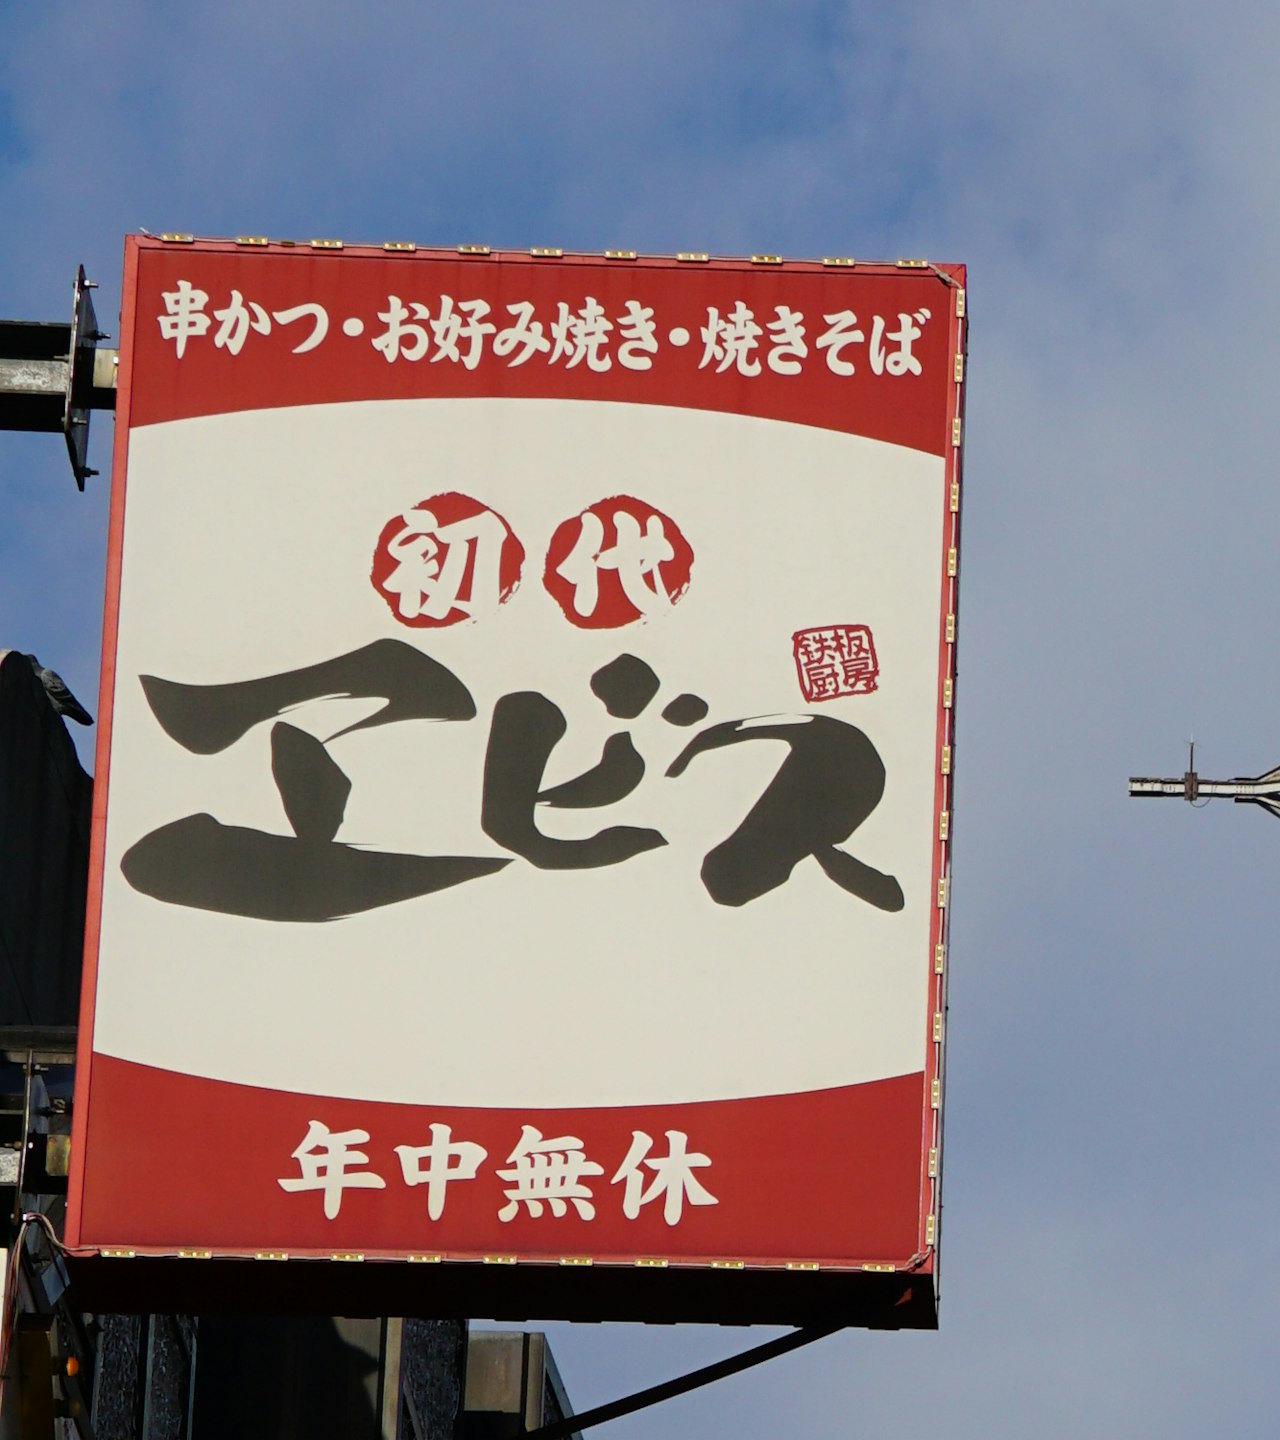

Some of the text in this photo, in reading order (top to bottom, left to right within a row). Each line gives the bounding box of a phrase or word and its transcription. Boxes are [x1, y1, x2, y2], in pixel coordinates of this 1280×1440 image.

[384, 508, 677, 618] 初代
[120, 637, 906, 923] エビス
[277, 1119, 720, 1228] 年中無休
